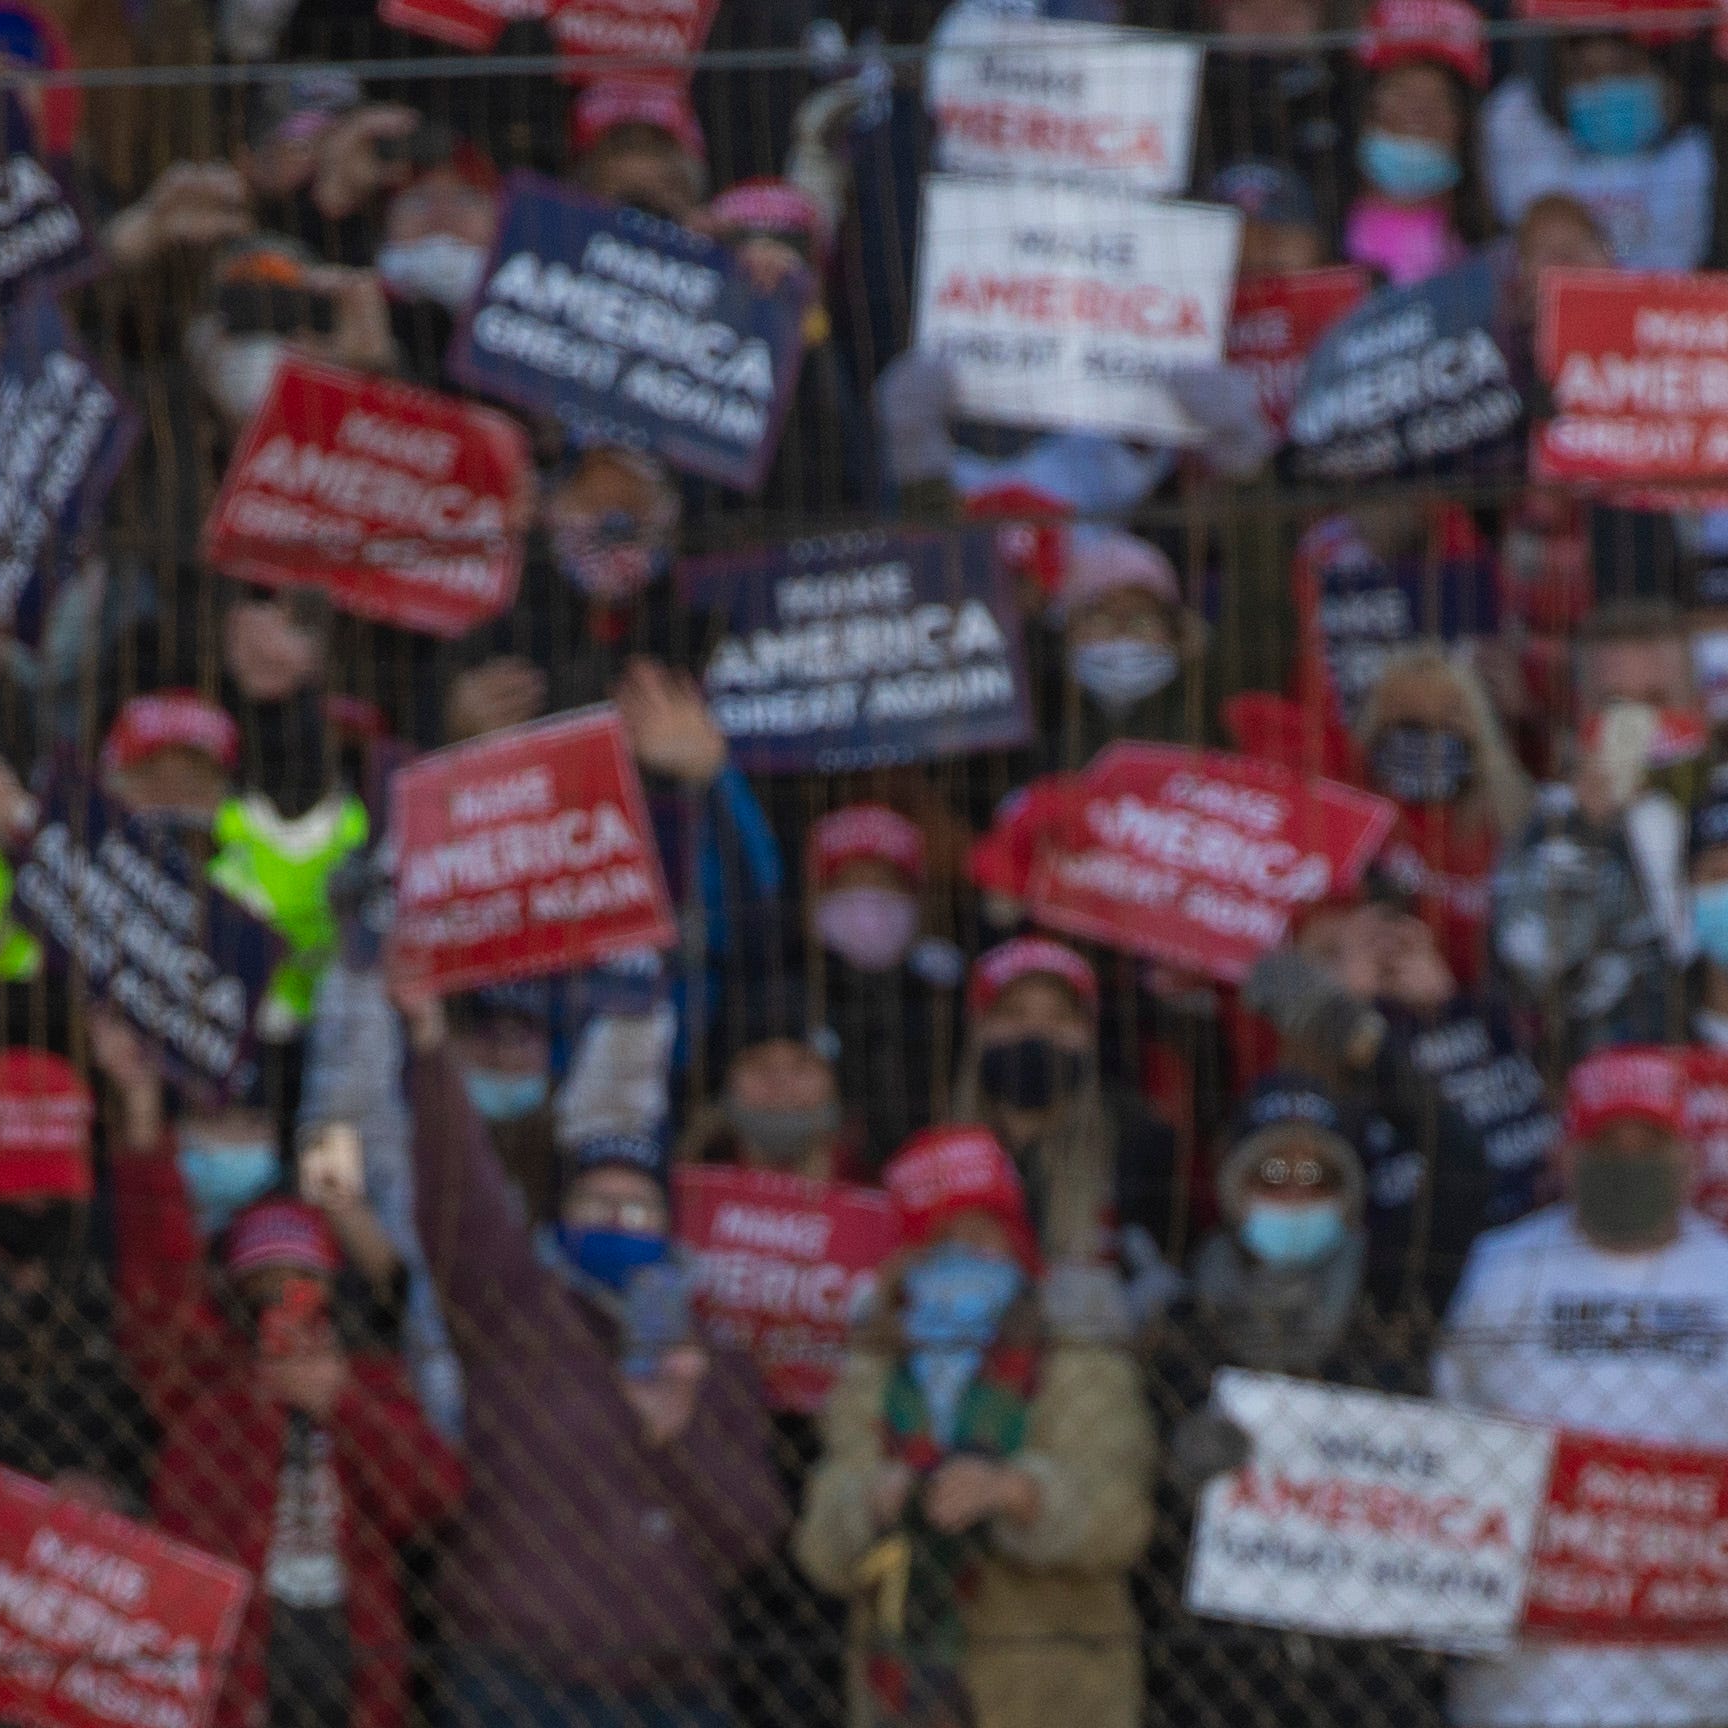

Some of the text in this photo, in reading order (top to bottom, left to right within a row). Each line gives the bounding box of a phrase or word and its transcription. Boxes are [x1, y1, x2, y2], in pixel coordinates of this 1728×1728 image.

[936, 98, 1168, 172] MERICA
[581, 231, 720, 312] MAKE
[936, 268, 1208, 338] AMERICA
[473, 302, 622, 393] GREAT
[490, 250, 773, 400] AMERICA
[334, 407, 459, 478] MAKE
[1547, 415, 1696, 472] GREAT
[246, 435, 506, 541] AMERICA
[776, 559, 912, 622] MAKE
[705, 598, 1008, 690] AMERICA
[708, 680, 862, 738] GREAT
[404, 800, 638, 905] AMERICA
[1230, 1462, 1510, 1549] AMERICA
[1579, 1457, 1718, 1512] MAKE
[29, 1525, 148, 1611] MAKE
